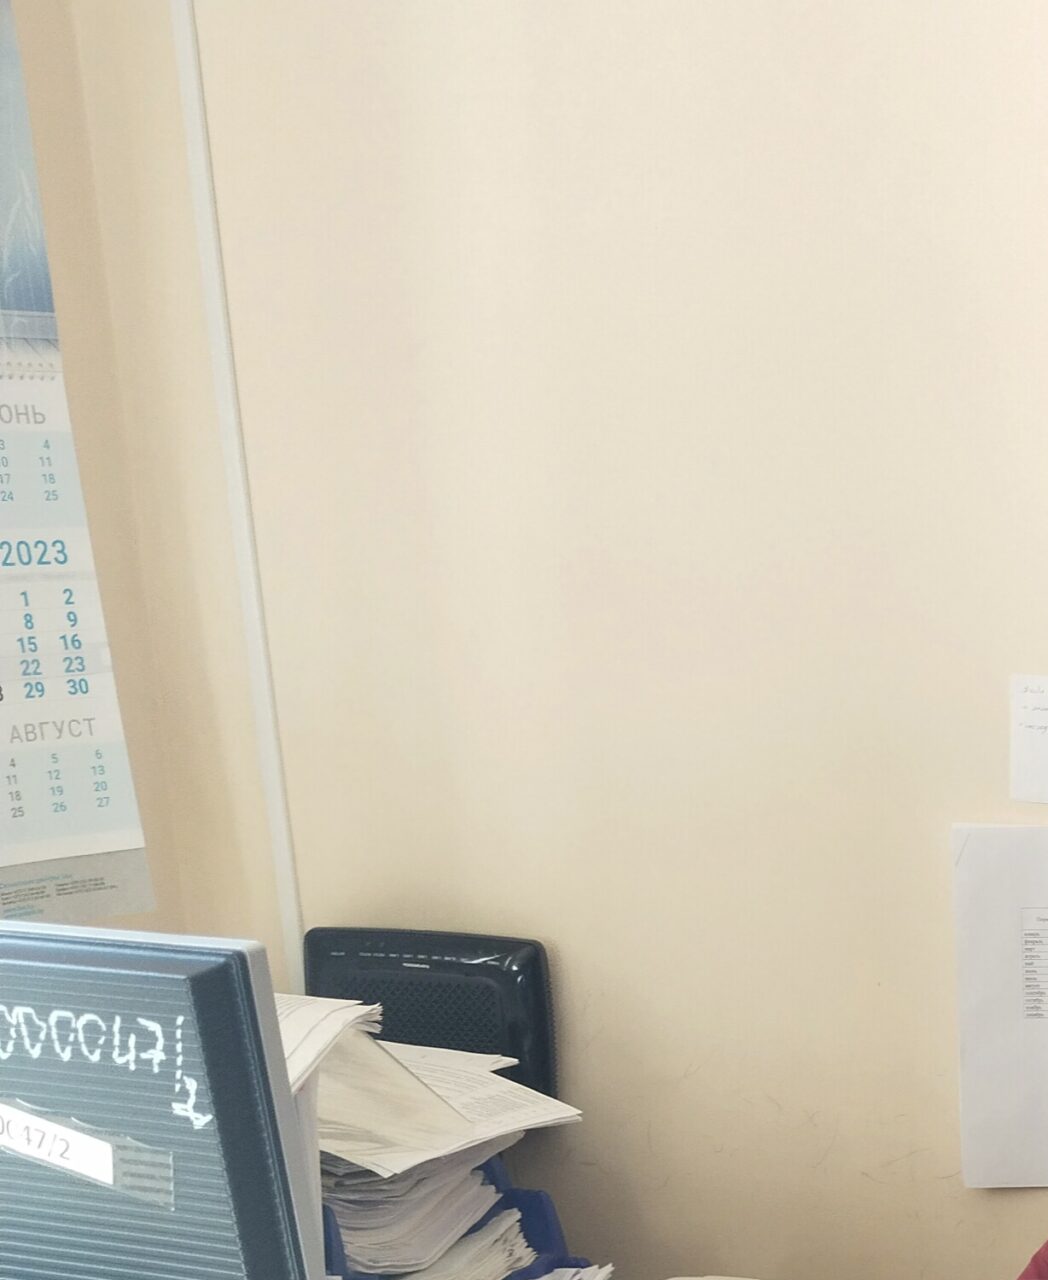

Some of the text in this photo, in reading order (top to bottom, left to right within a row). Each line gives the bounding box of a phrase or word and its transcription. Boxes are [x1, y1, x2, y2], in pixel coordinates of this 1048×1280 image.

[43, 440, 50, 450] 4
[39, 456, 52, 467] 11
[42, 473, 56, 484] 18
[0, 490, 58, 501] 24 25
[1, 540, 68, 566] 2023
[20, 588, 75, 607] 1 2
[24, 611, 78, 630] 8 9
[17, 634, 82, 653] 15 16
[20, 656, 86, 676] 22 23
[24, 681, 45, 699] 29
[66, 678, 89, 696] 30
[9, 717, 97, 744] АВГУСТ
[9, 749, 103, 768] 4 5 6
[6, 766, 105, 785] 11 12 13
[9, 781, 108, 802] 18 19 20
[11, 797, 111, 818] 25 26 27
